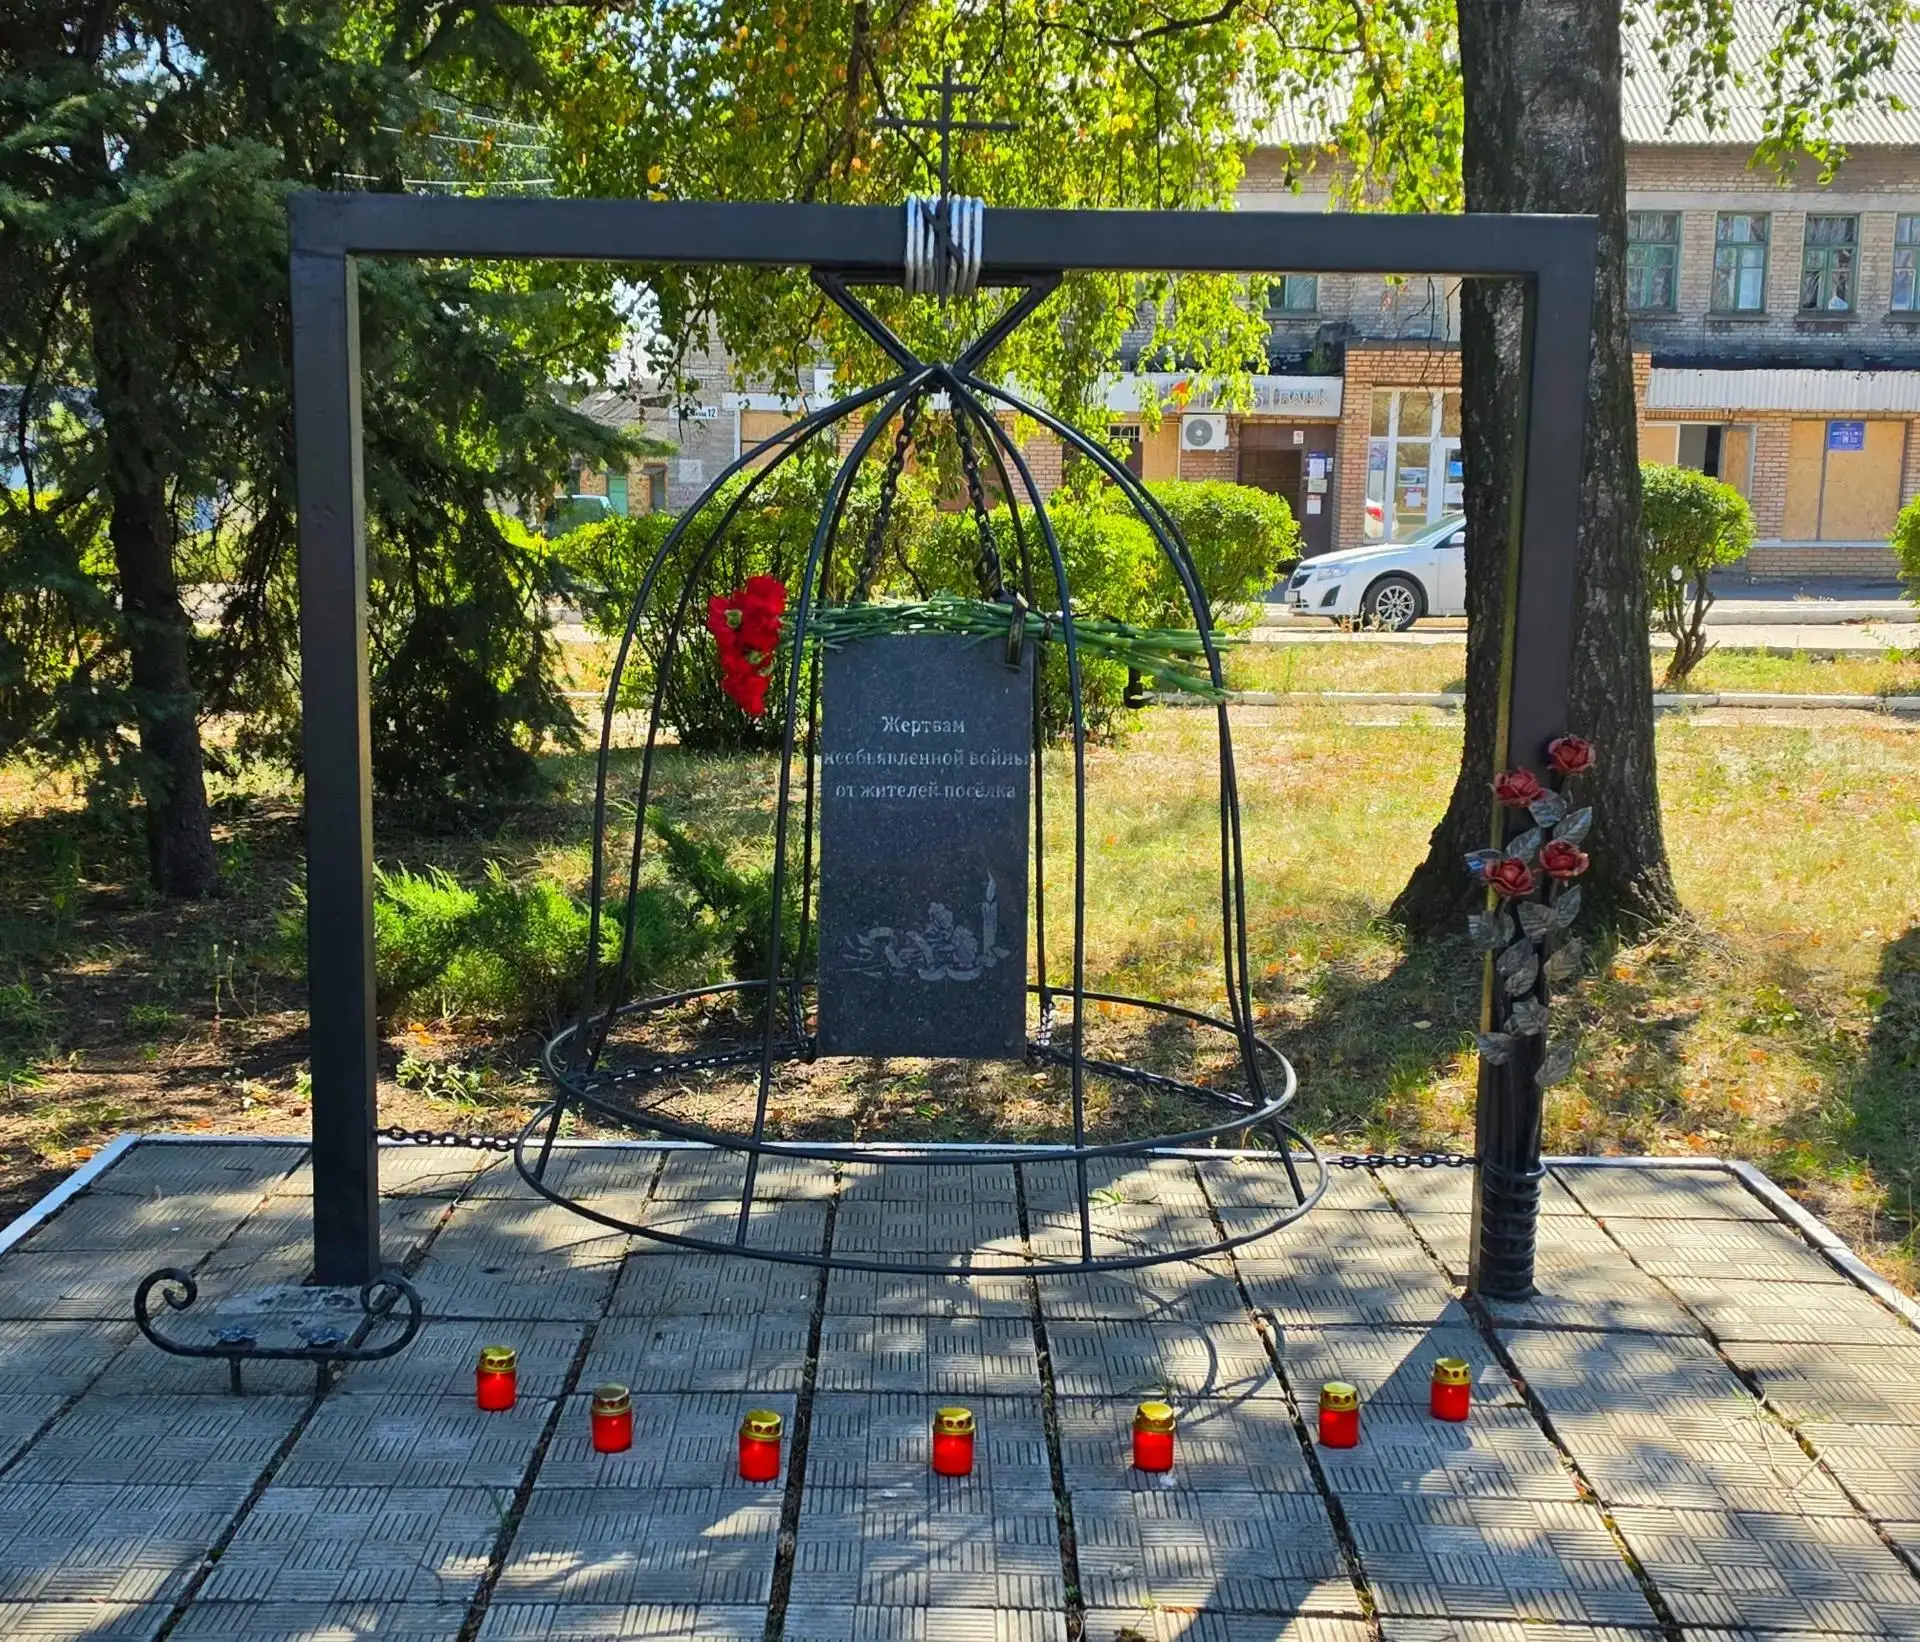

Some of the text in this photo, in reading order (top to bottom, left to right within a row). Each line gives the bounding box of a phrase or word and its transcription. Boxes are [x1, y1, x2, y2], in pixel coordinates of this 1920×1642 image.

[707, 407, 716, 418] 12
[881, 715, 965, 737] Жертвам
[969, 748, 1029, 766] войны
[835, 784, 855, 799] от
[860, 780, 938, 799] жителей
